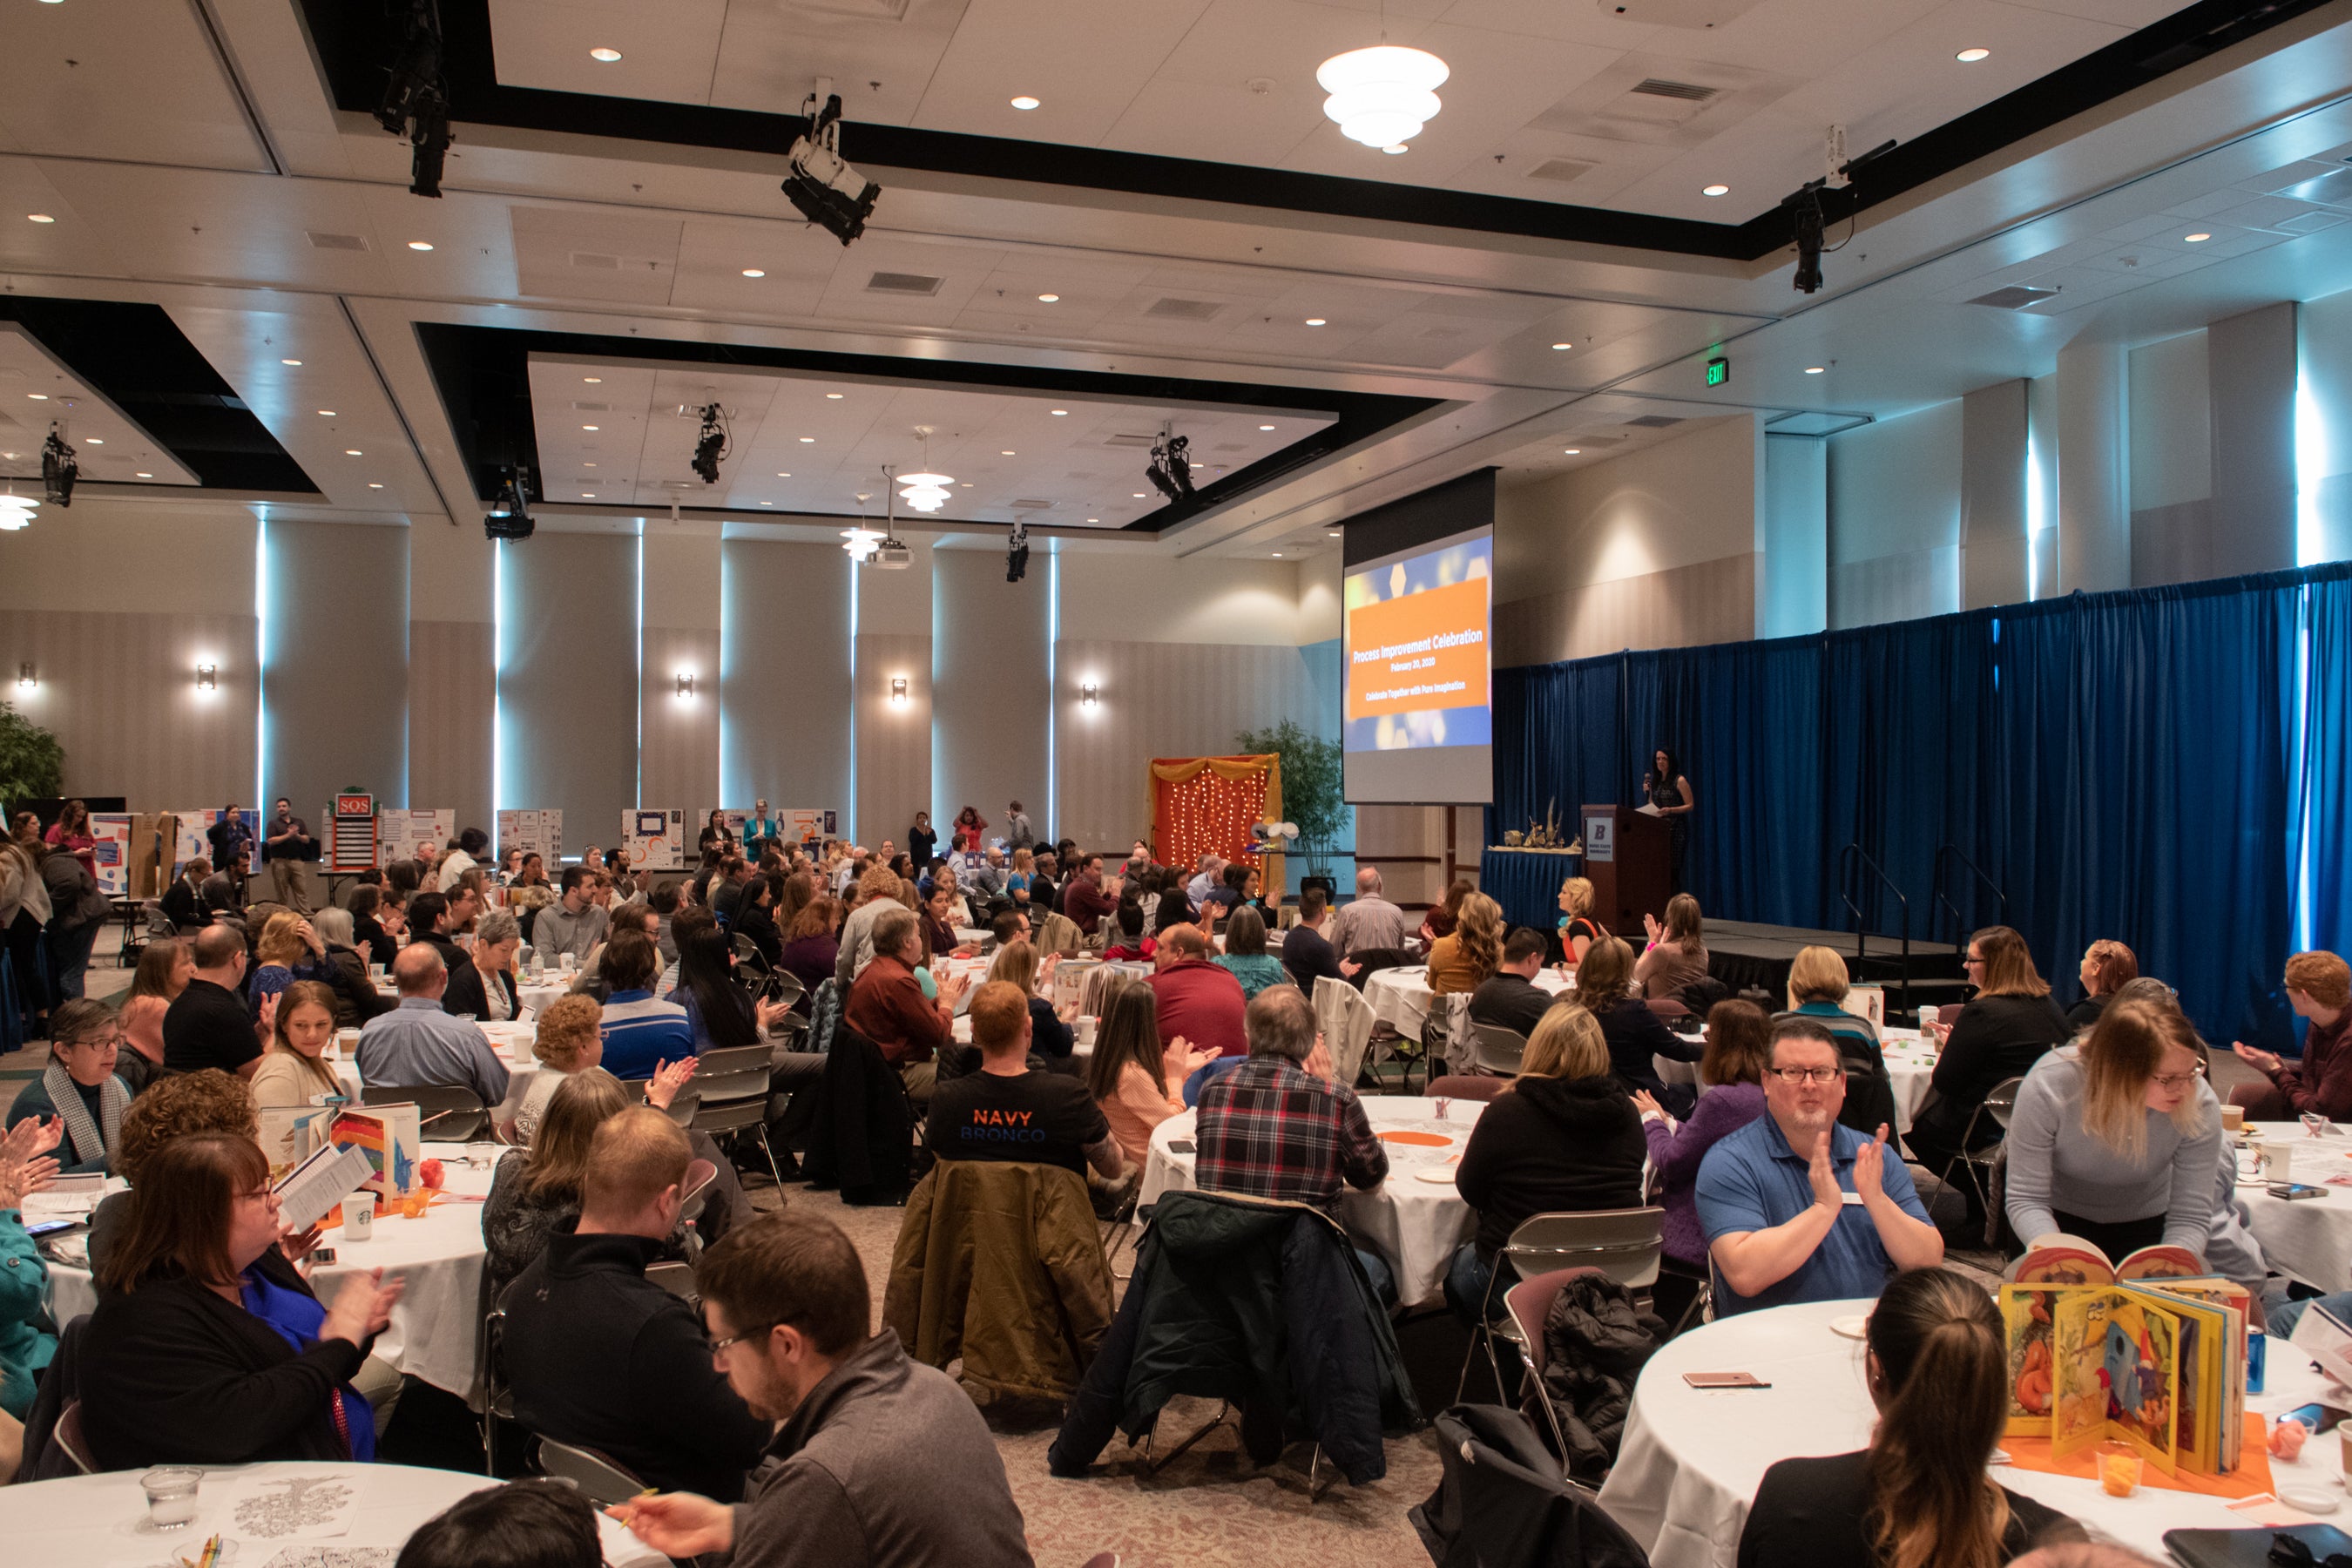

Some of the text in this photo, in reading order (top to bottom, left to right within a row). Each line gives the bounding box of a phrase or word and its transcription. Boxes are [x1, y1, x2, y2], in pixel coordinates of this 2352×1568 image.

[1709, 363, 1723, 385] EXIT
[1353, 628, 1483, 664] Process Improvement Celebration
[1390, 662, 1412, 672] February
[1422, 656, 1436, 668] 2020
[1366, 691, 1388, 701] Celebrate
[1388, 688, 1409, 700] Together
[1434, 680, 1465, 693] Imagination
[341, 800, 369, 811] SOS
[1594, 824, 1605, 840] B
[973, 1109, 1032, 1126] NAVY
[960, 1125, 1046, 1143] BRONCO
